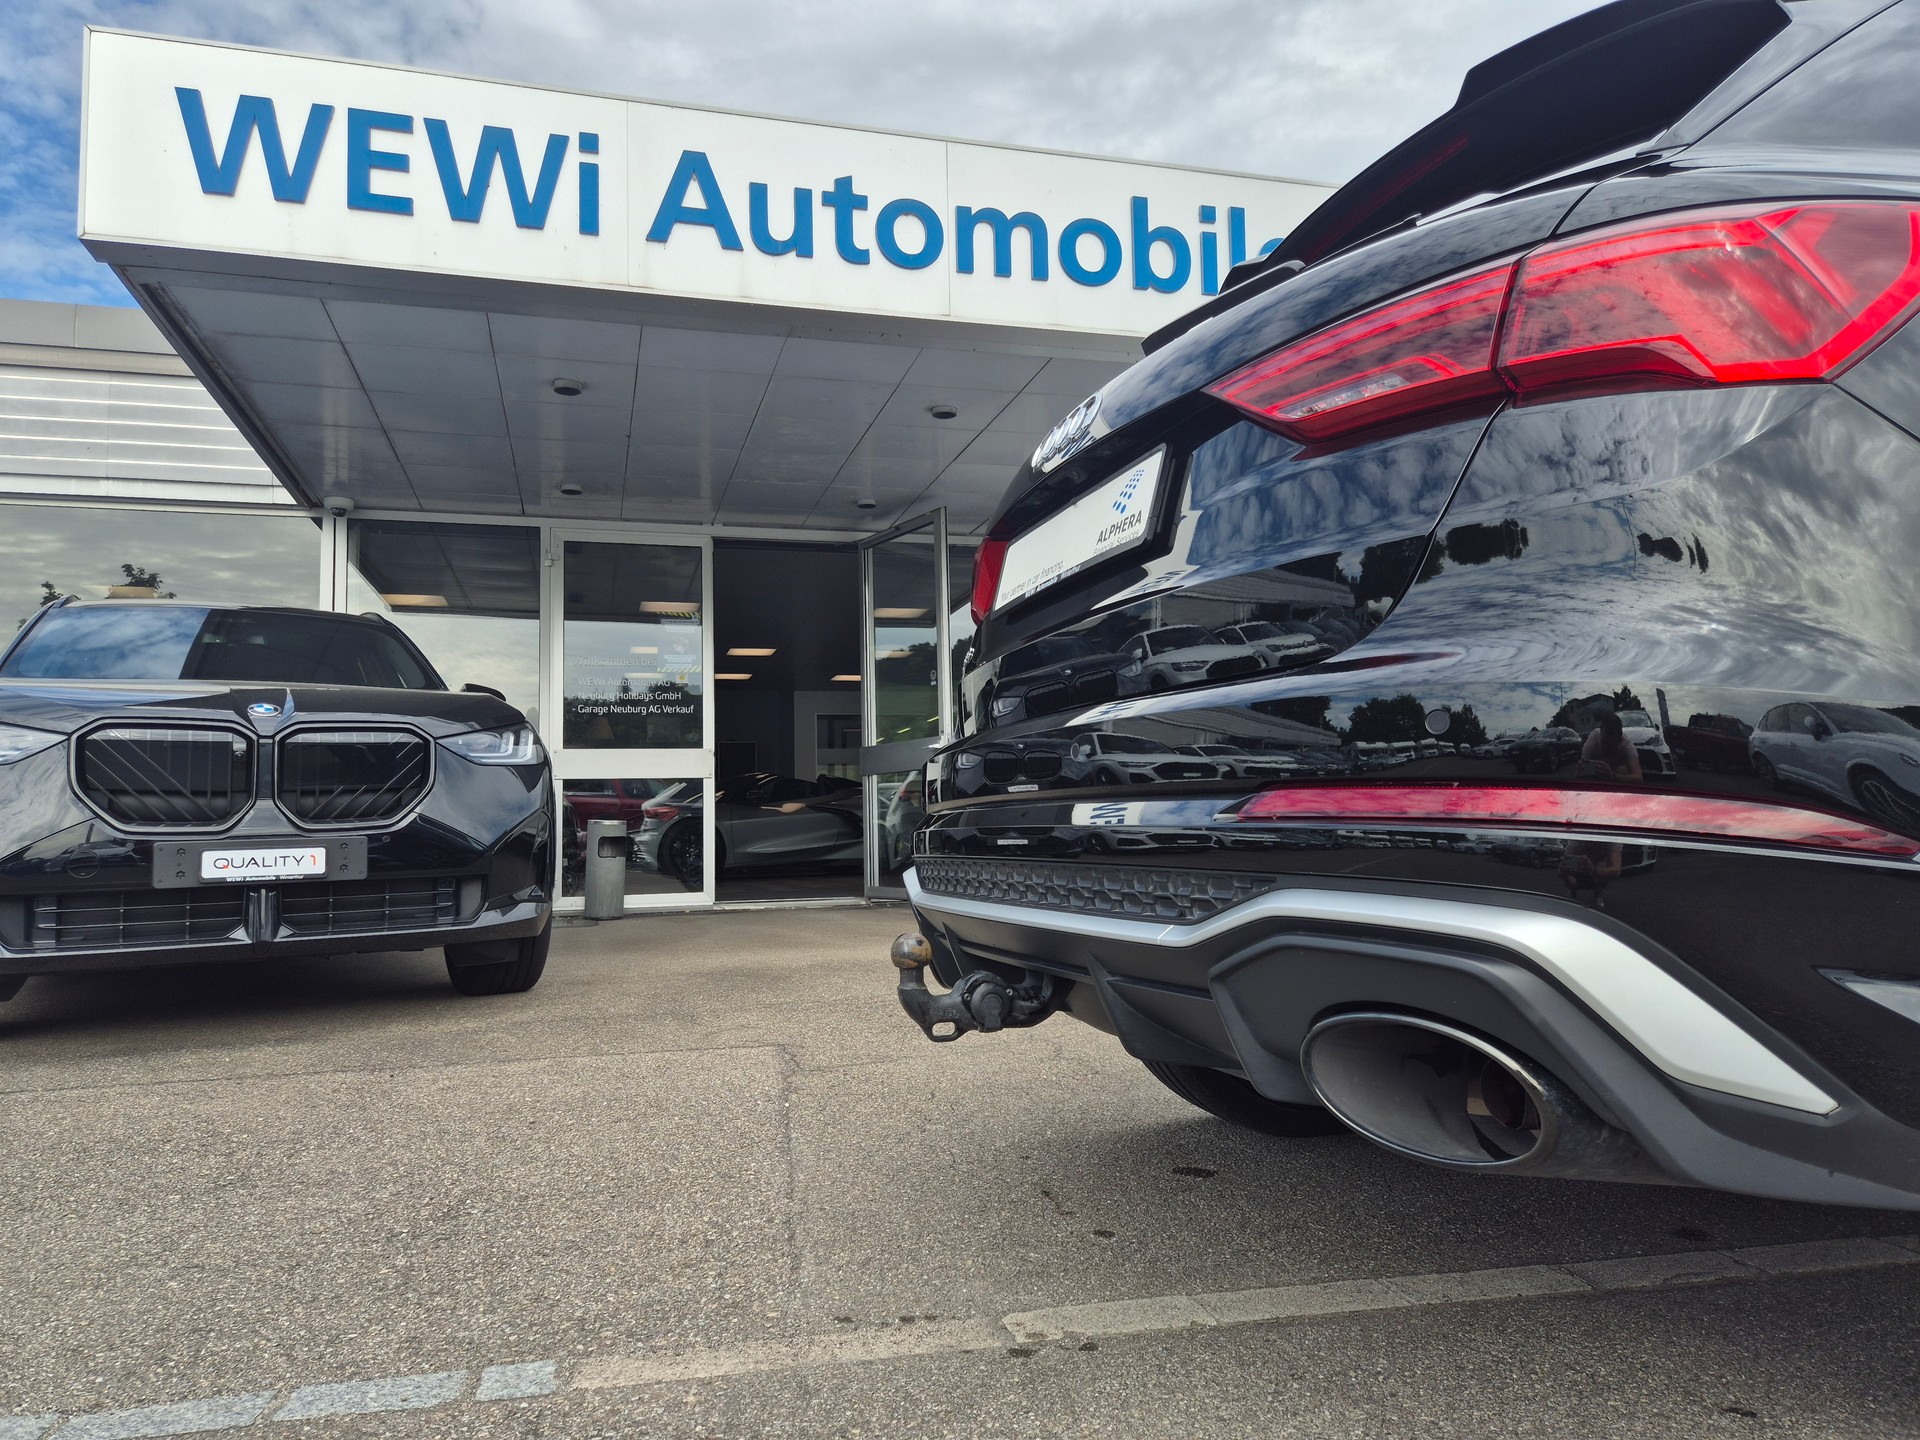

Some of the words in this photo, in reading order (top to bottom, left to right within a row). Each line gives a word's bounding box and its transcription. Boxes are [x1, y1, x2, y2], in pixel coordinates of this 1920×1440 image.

[174, 86, 600, 235] WEWi
[647, 151, 1286, 296] Automobil
[1095, 509, 1142, 546] ALPHERA
[573, 656, 638, 668] Willkommen
[640, 657, 657, 668] bei
[657, 679, 671, 687] AG
[577, 691, 615, 702] Neuburg
[616, 691, 653, 702] Holidays
[655, 691, 682, 700] GmbH
[577, 704, 609, 715] Garage
[610, 704, 647, 715] Neuburg
[648, 705, 661, 714] AG
[662, 704, 695, 714] Verkauf
[213, 854, 305, 870] QUALITY
[309, 854, 317, 866] 1
